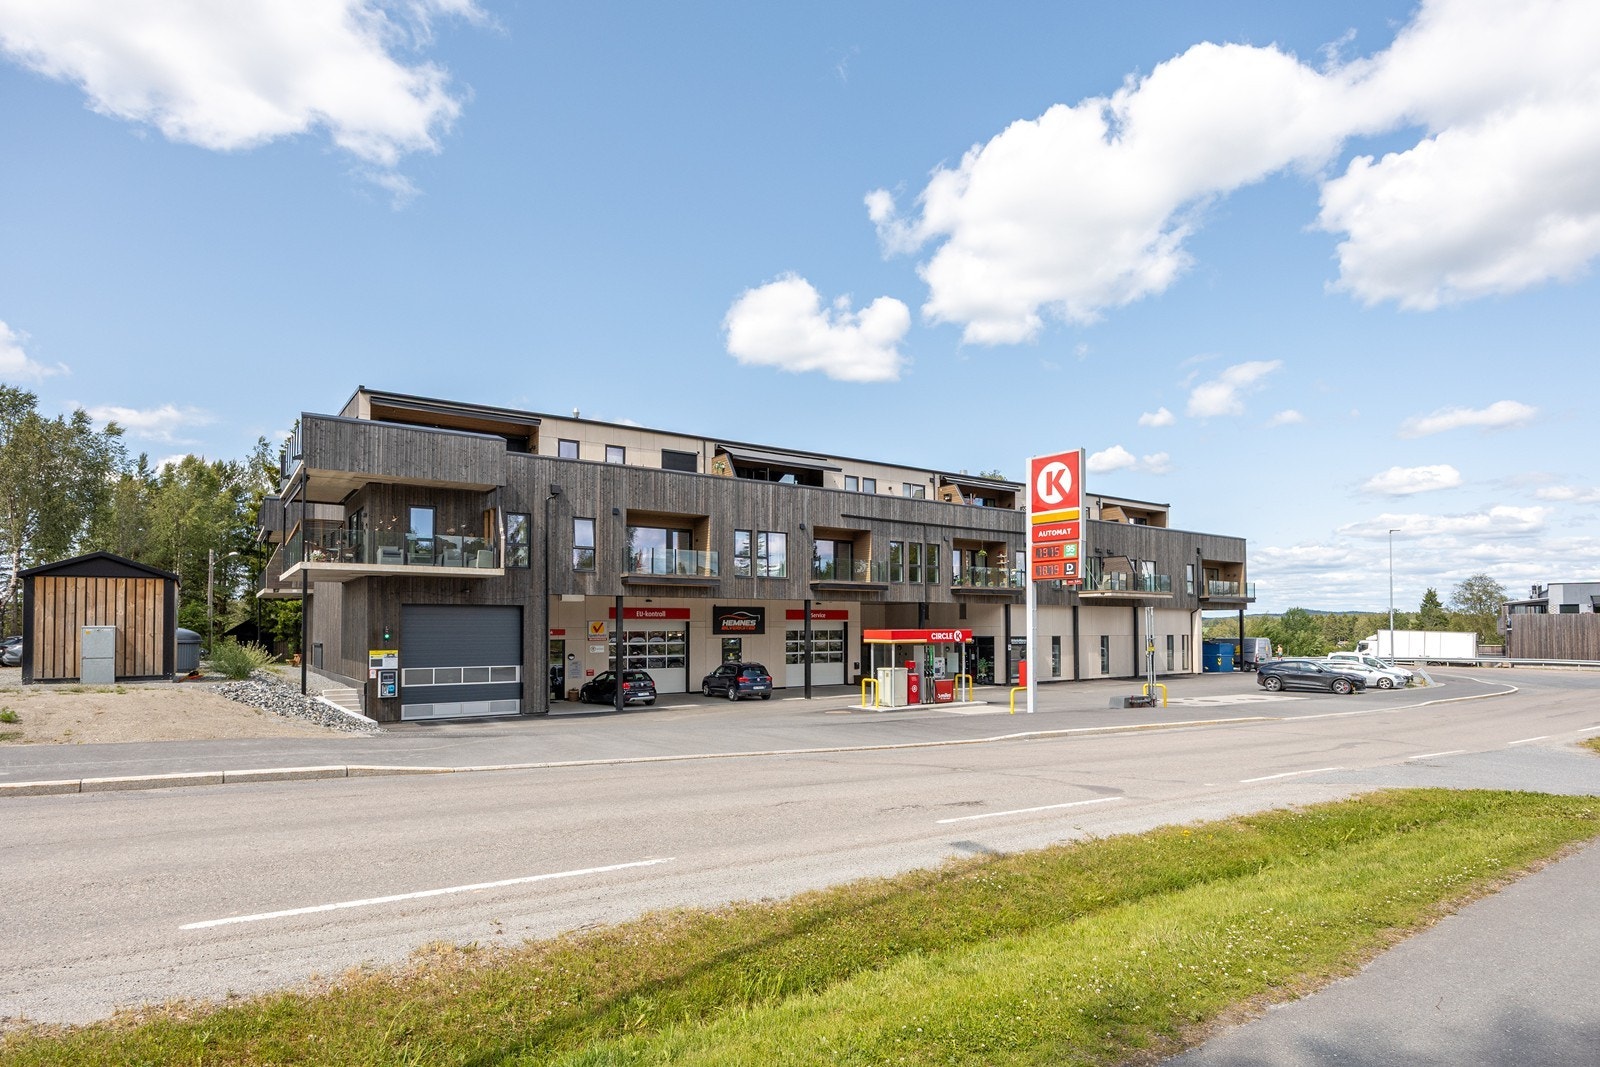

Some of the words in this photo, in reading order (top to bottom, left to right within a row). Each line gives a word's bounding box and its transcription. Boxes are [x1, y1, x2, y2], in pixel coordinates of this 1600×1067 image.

[1046, 469, 1068, 500] K
[1038, 528, 1072, 537] AUTOMAT
[1066, 545, 1075, 553] 95
[931, 632, 954, 640] CIRCLE
